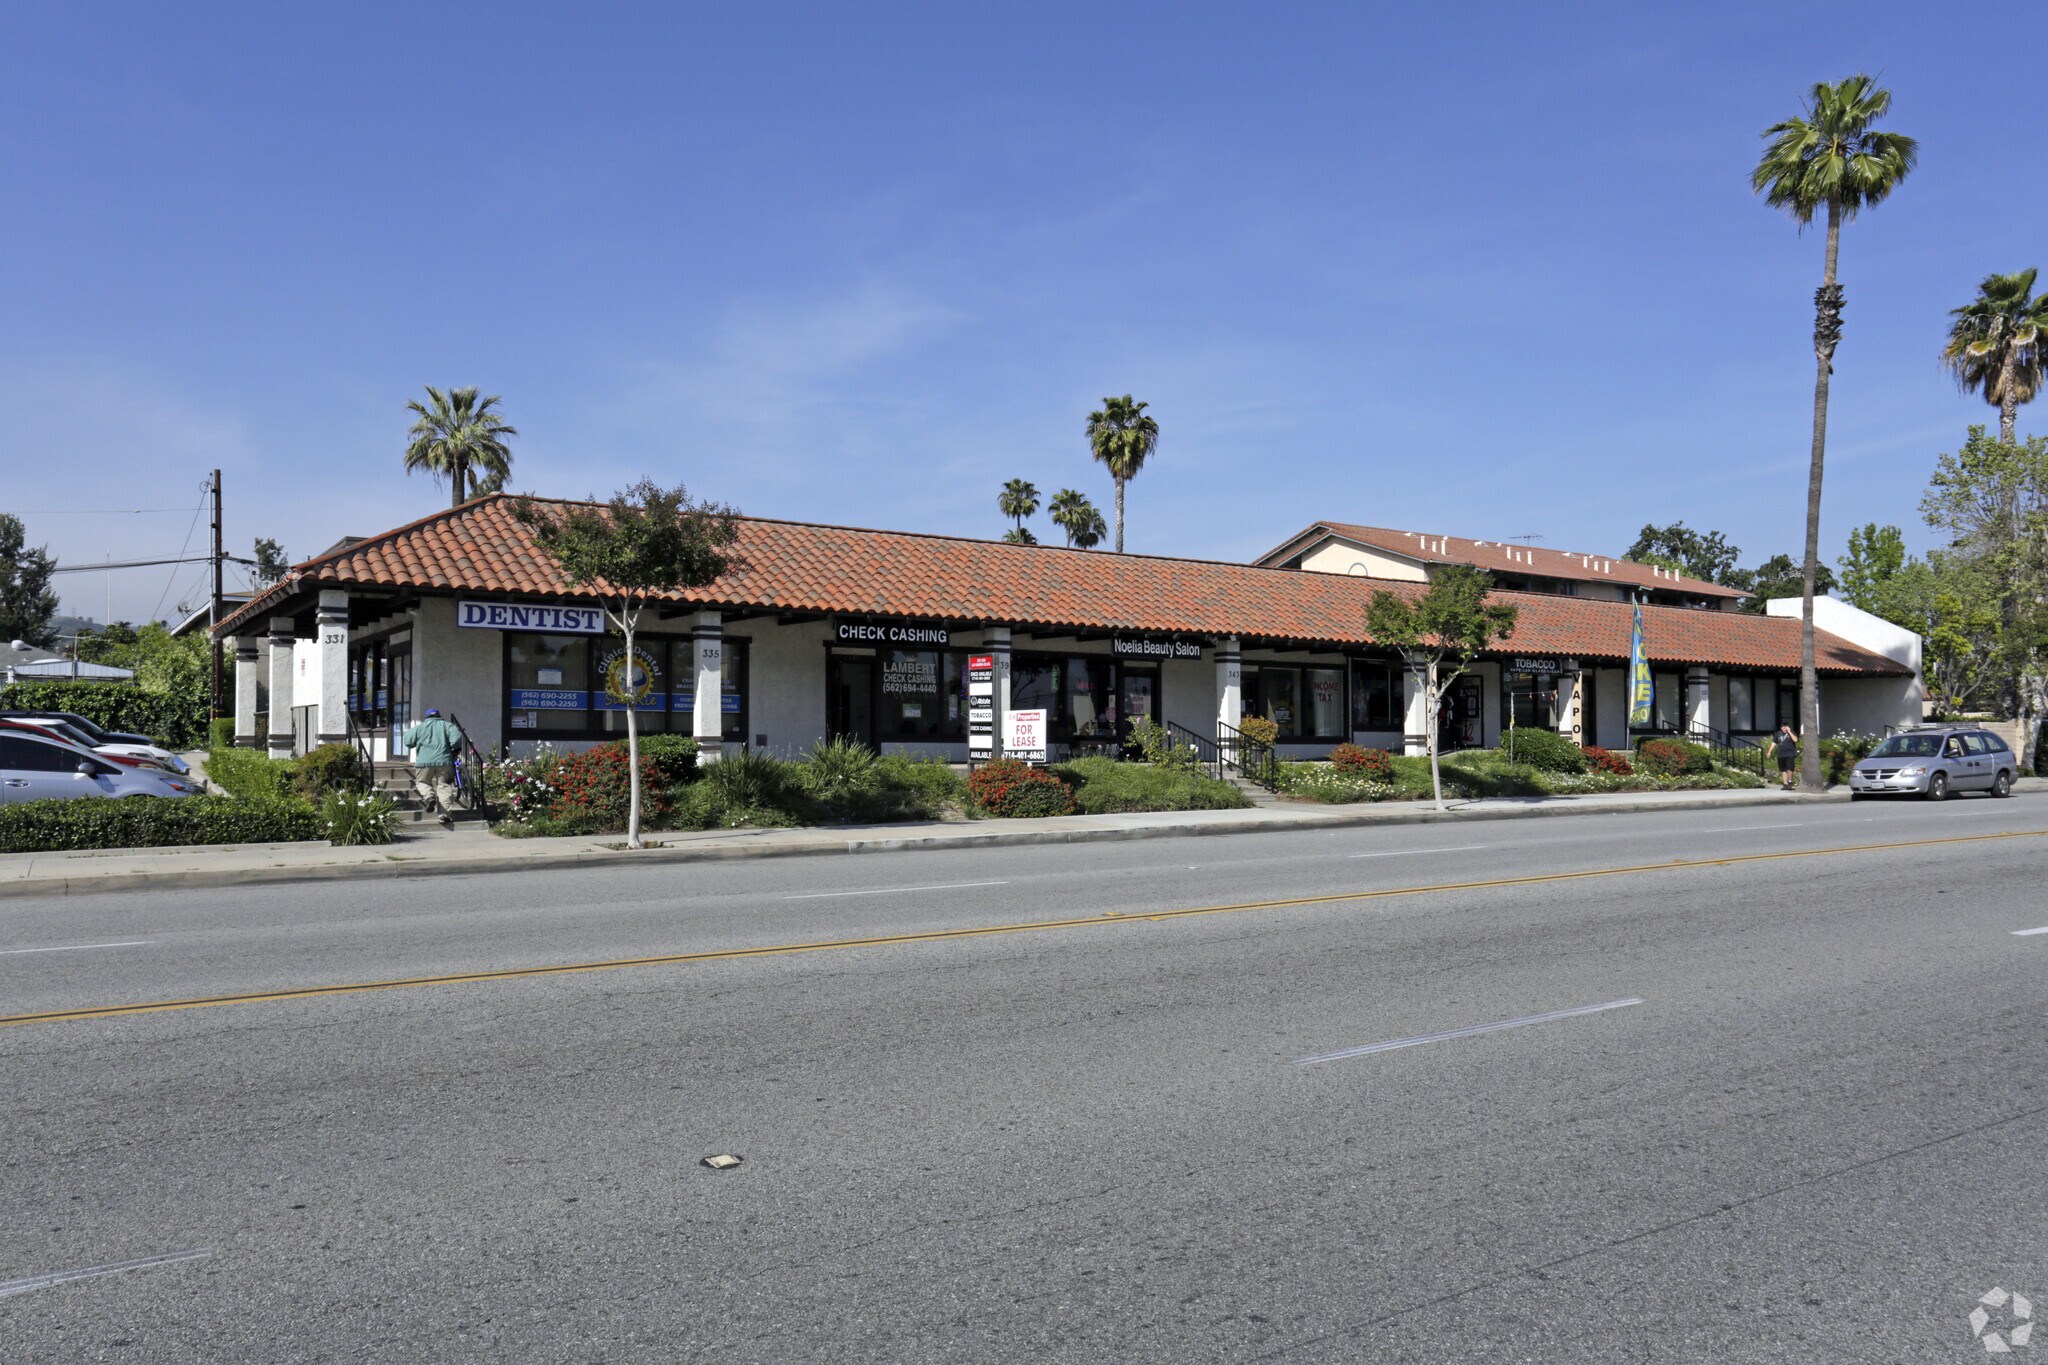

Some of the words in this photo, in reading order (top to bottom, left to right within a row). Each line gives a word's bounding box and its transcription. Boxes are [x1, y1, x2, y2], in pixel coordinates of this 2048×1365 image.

[464, 604, 599, 629] DENTIST
[325, 634, 345, 644] 331
[839, 625, 886, 640] CHECK
[890, 627, 947, 643] CASHING
[702, 649, 720, 658] 335
[1114, 639, 1142, 653] Noelia
[1144, 641, 1174, 658] Beauty
[1175, 642, 1200, 656] Salon
[883, 662, 936, 674] LAMBERT
[1515, 659, 1555, 670] TOBACCO
[883, 673, 906, 683] CHECK
[907, 674, 937, 684] CASHING
[1312, 681, 1339, 691] INCOME
[521, 691, 539, 699] (562)
[541, 692, 577, 700] 690-2255
[1318, 692, 1333, 703] TAX
[541, 700, 577, 708] 690-2250
[1016, 724, 1033, 735] FOR
[1012, 736, 1036, 747] LEASE
[970, 751, 992, 759] AVAILABLE
